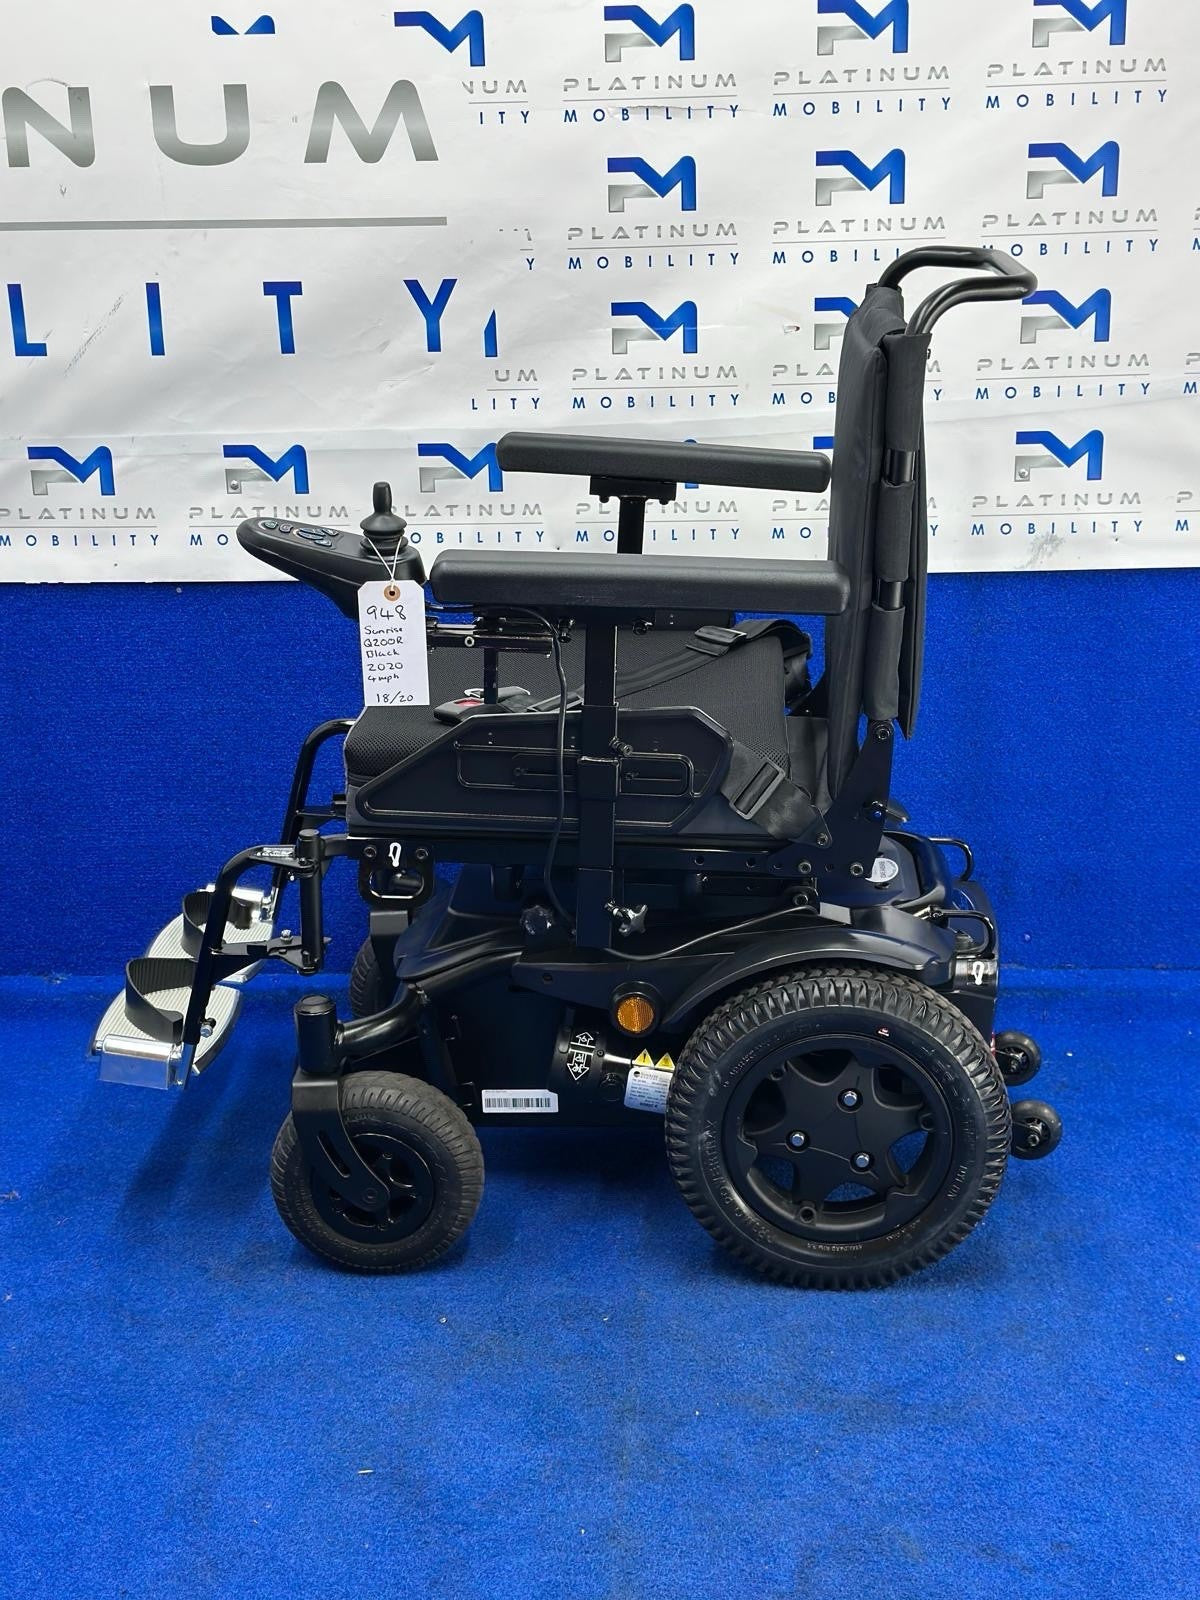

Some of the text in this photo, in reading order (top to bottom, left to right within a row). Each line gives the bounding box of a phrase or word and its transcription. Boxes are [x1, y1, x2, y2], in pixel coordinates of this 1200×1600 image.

[774, 66, 949, 85] PLATINUM
[987, 58, 1166, 77] PLATINUM
[563, 74, 736, 92] PLATINUM
[773, 97, 950, 116] MOBILITY
[986, 89, 1167, 108] MOBILITY
[564, 105, 738, 122] MOBILITY
[2, 79, 439, 168] NUM
[773, 216, 945, 235] PLATINUM
[982, 209, 1157, 228] PLATINUM
[568, 223, 736, 240] PLATINUM
[568, 253, 739, 269] MOBILITY
[772, 248, 900, 264] MOBILI
[7, 278, 457, 356] LITY
[977, 353, 1149, 371] PLATINUM
[572, 366, 737, 381] PLATINUM
[976, 383, 1150, 400] MOBILITY
[573, 394, 739, 409] MOBILITY
[972, 492, 1141, 508] PLATINUM
[189, 505, 349, 519] PLATINUM
[391, 503, 543, 517] LATINUM
[576, 528, 740, 542] MOILITY
[971, 521, 1142, 536] MOBILITY
[0, 535, 159, 547] MOBILITY
[410, 531, 545, 545] OBILITY
[366, 604, 407, 621] 948
[367, 662, 403, 672] 2020
[376, 691, 414, 705] 18/20
